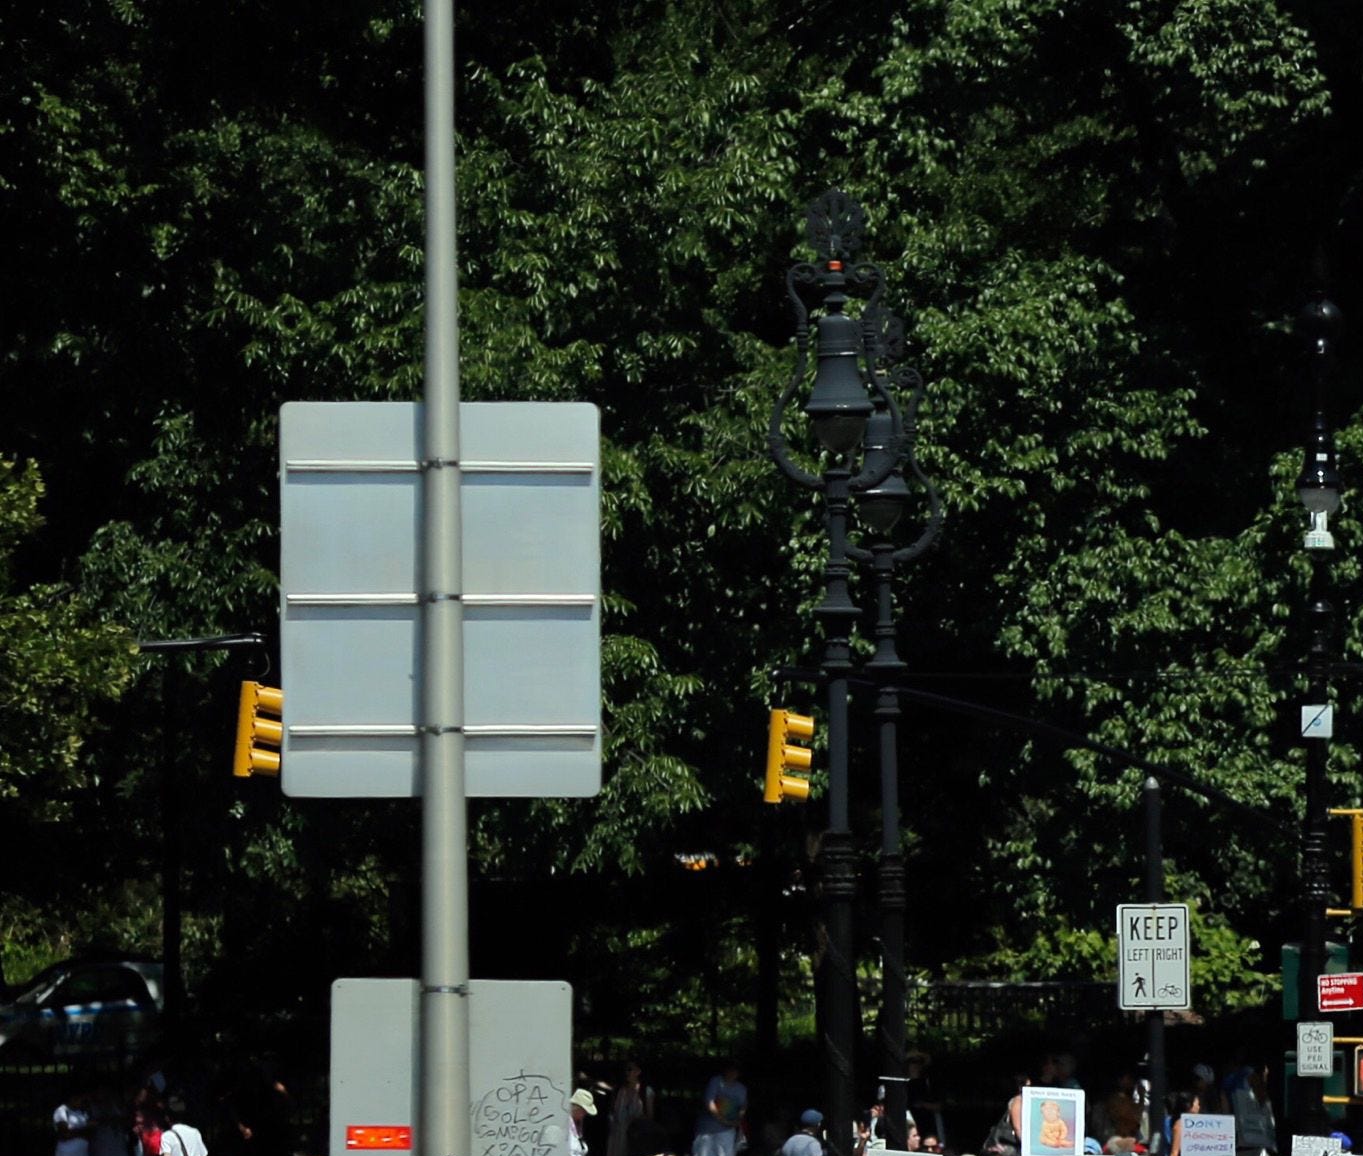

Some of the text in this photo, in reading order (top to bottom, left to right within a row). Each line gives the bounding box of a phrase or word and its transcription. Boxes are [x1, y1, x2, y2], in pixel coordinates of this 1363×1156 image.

[1129, 915, 1179, 941] KEEP
[1127, 948, 1149, 963] LEFT
[1156, 948, 1184, 963] RIGHT
[1301, 1063, 1329, 1071] SIGNAL
